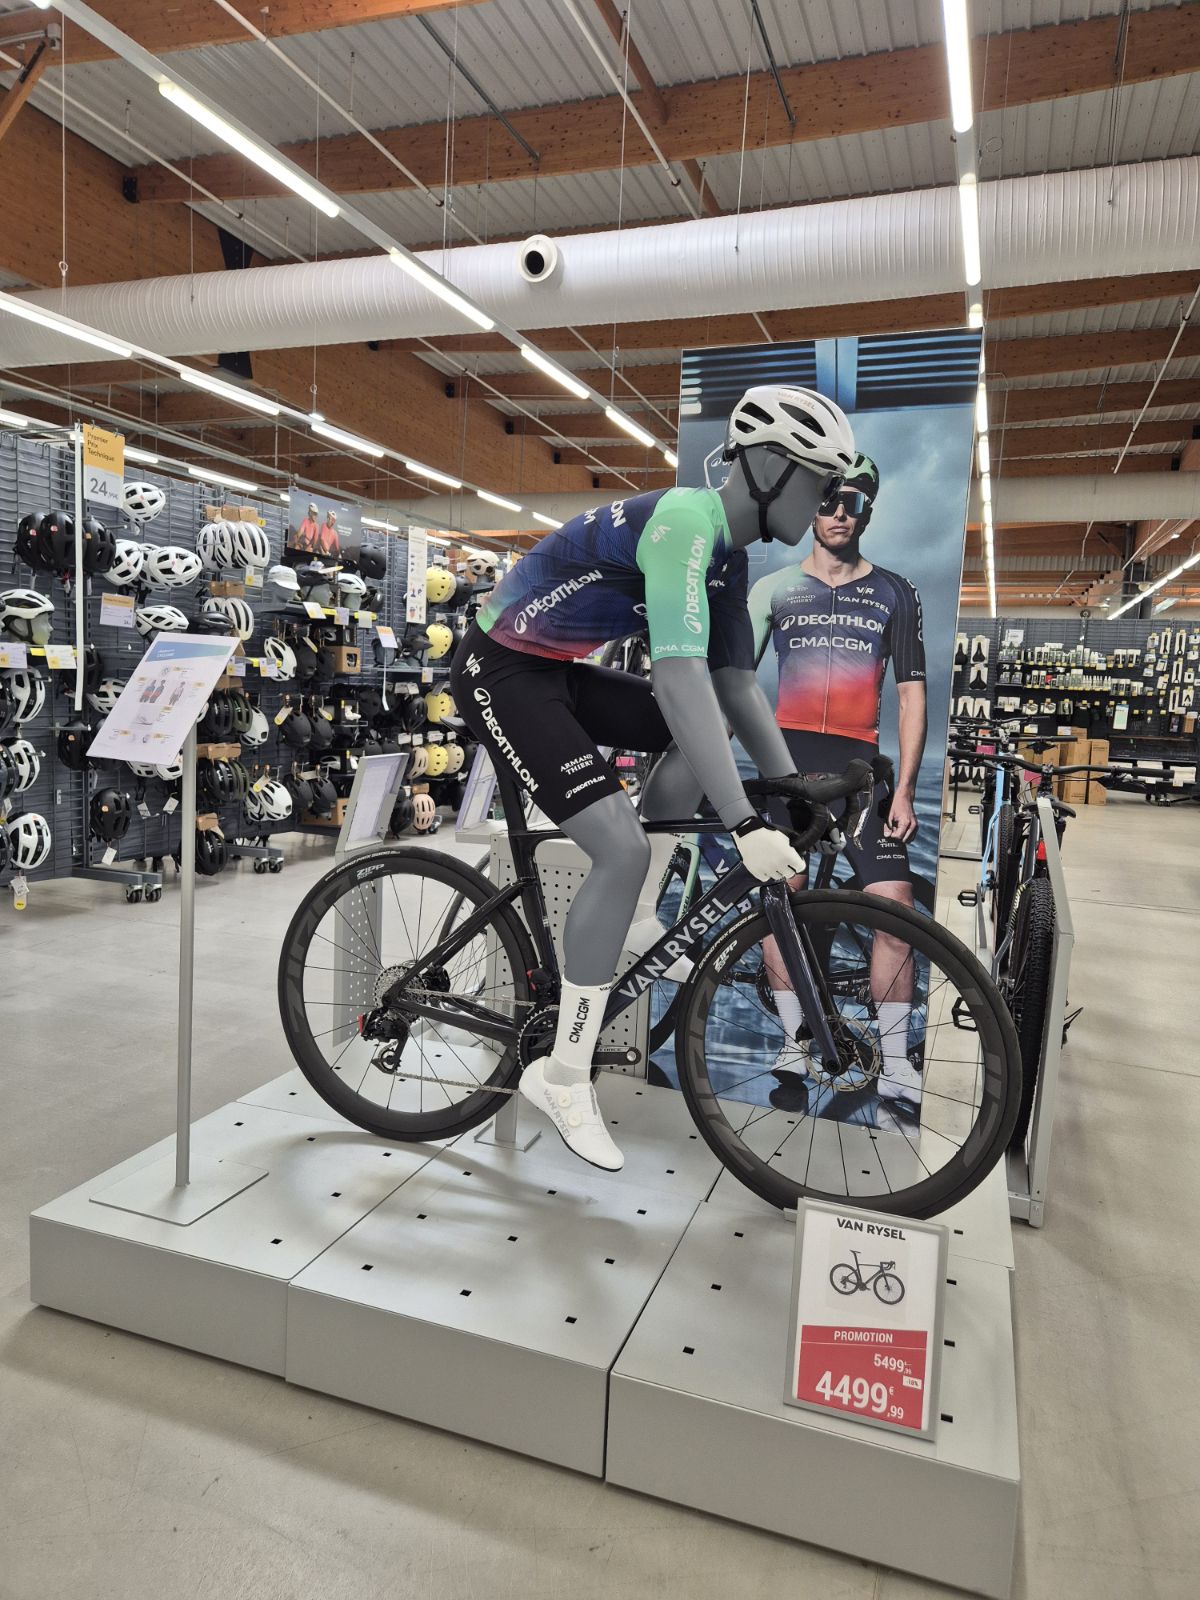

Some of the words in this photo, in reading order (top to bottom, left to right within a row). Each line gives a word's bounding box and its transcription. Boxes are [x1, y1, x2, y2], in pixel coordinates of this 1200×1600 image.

[88, 447, 115, 461] Technique
[525, 569, 603, 618] DECATHLON
[837, 595, 860, 603] VAN
[862, 599, 890, 614] RYSEL
[797, 614, 886, 635] DECATHLON
[655, 645, 678, 654] CMA
[681, 645, 705, 653] CGM
[789, 636, 829, 649] CMA
[832, 636, 873, 655] CGM
[481, 706, 539, 793] DECATHLON
[560, 754, 593, 772] ARMAND
[566, 760, 594, 775] THIERY
[572, 775, 606, 794] DECATHLON
[618, 956, 667, 998] VAN
[664, 897, 734, 959] RYSEL
[576, 997, 590, 1021] CGM
[569, 1021, 585, 1044] CMA
[836, 1217, 863, 1232] VAN
[866, 1224, 906, 1241] RYSEL
[833, 1330, 893, 1343] PROMOTION
